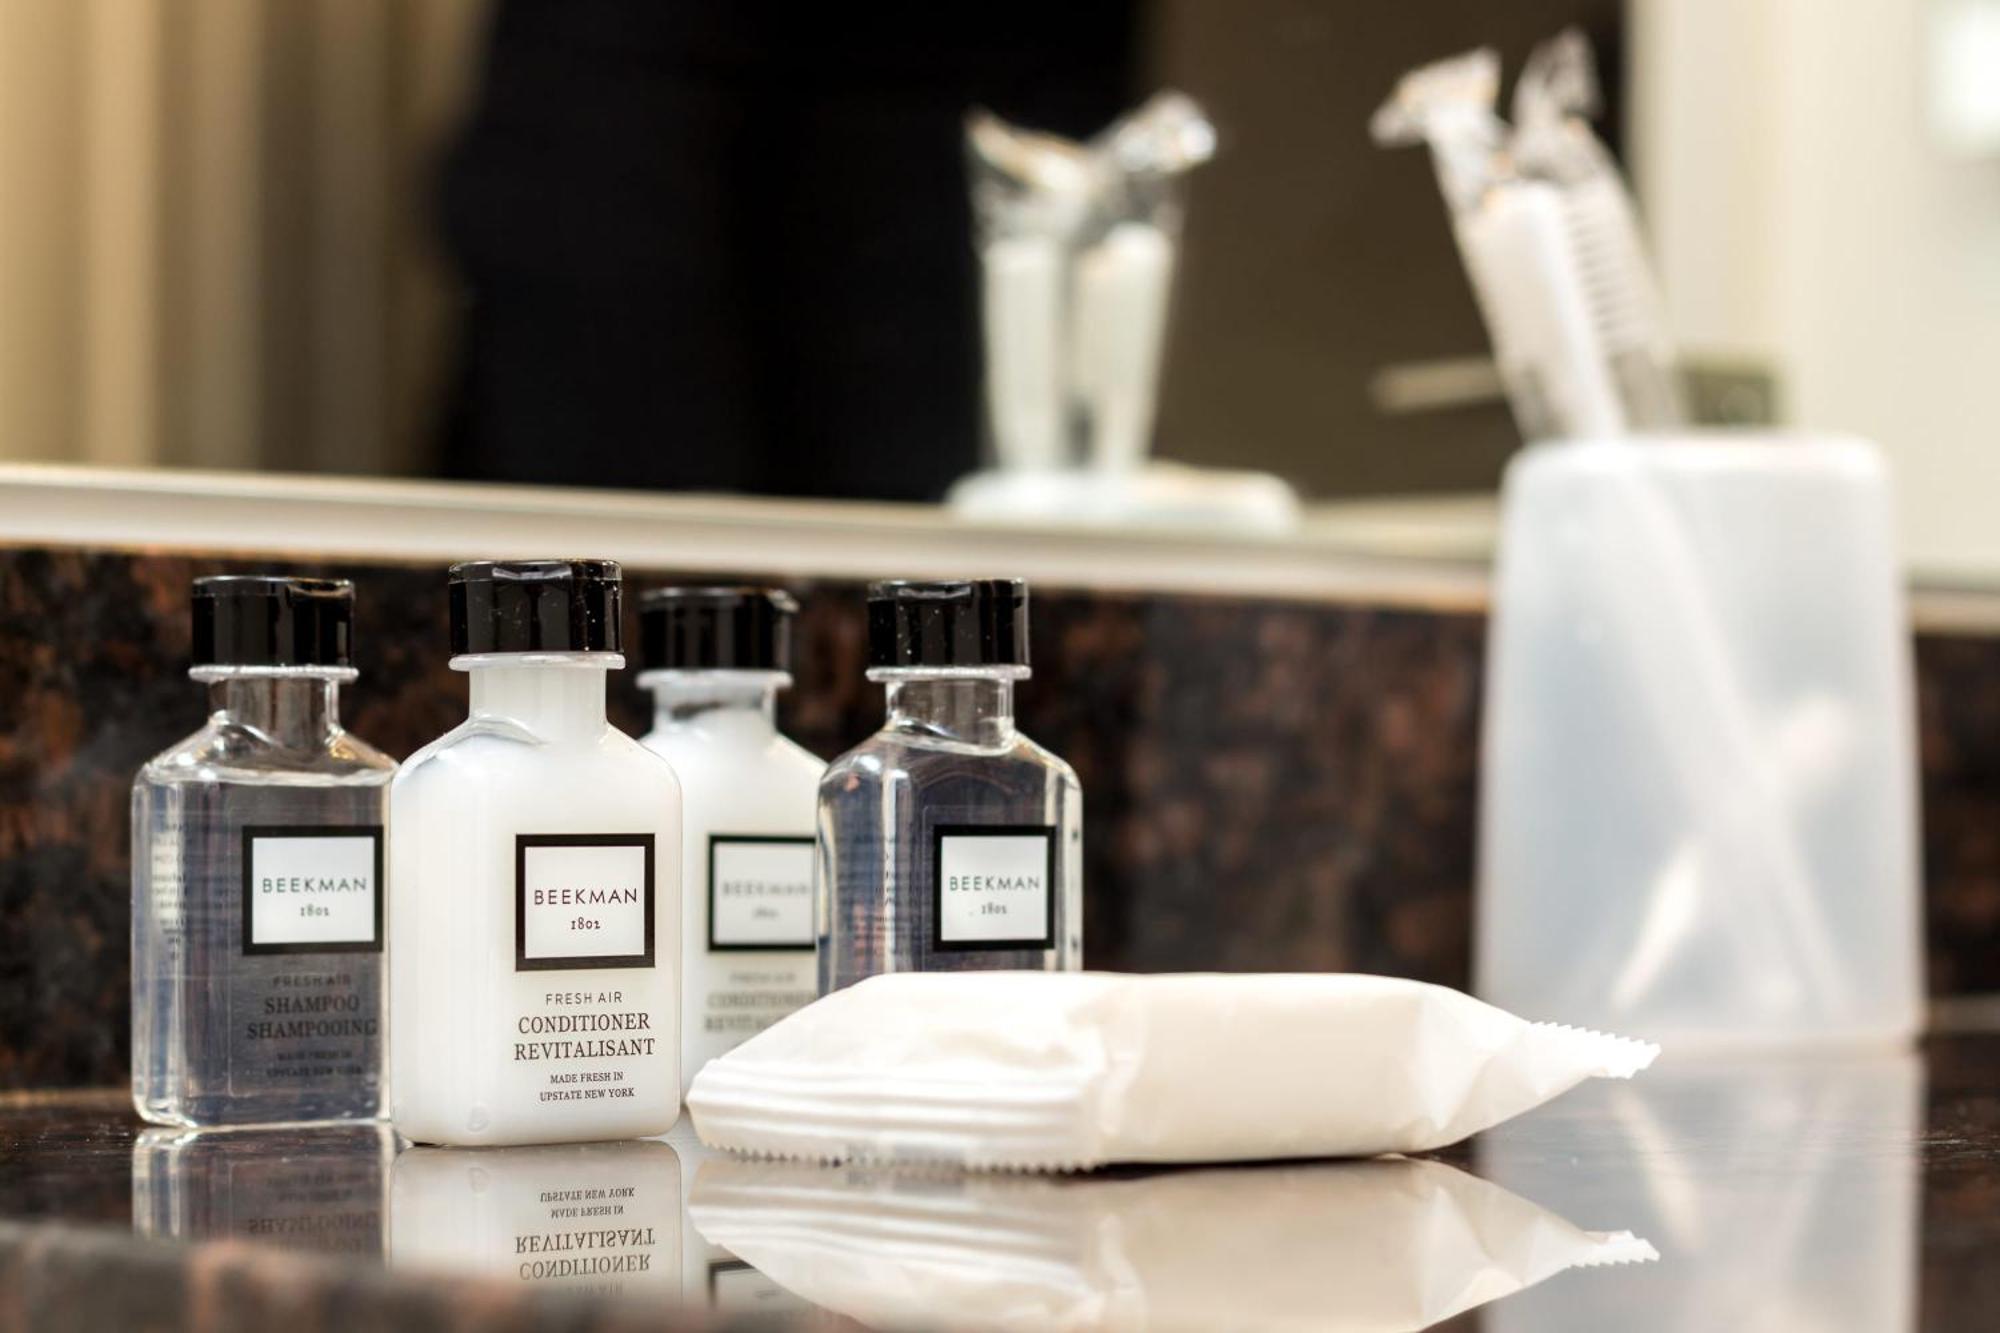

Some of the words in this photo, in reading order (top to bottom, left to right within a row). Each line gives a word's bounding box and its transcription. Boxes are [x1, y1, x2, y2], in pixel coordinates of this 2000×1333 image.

[262, 876, 367, 893] BEEKMAN
[948, 875, 1040, 892] BEEKMAN
[534, 888, 637, 905] BEEKMAN
[570, 917, 601, 930] 1802
[264, 994, 360, 1015] SHAMPOO
[545, 992, 593, 1006] FRESH
[598, 991, 623, 1003] AIR
[246, 1018, 378, 1040] SHAMPOOING
[518, 1012, 651, 1035] CONDITIONER
[514, 1037, 656, 1061] REVITALISANT
[550, 1073, 578, 1084] MADE
[580, 1071, 611, 1083] FRESH
[613, 1071, 624, 1081] IN
[539, 1089, 582, 1102] UPSTATE
[584, 1088, 607, 1099] NEW
[608, 1087, 635, 1098] YORK
